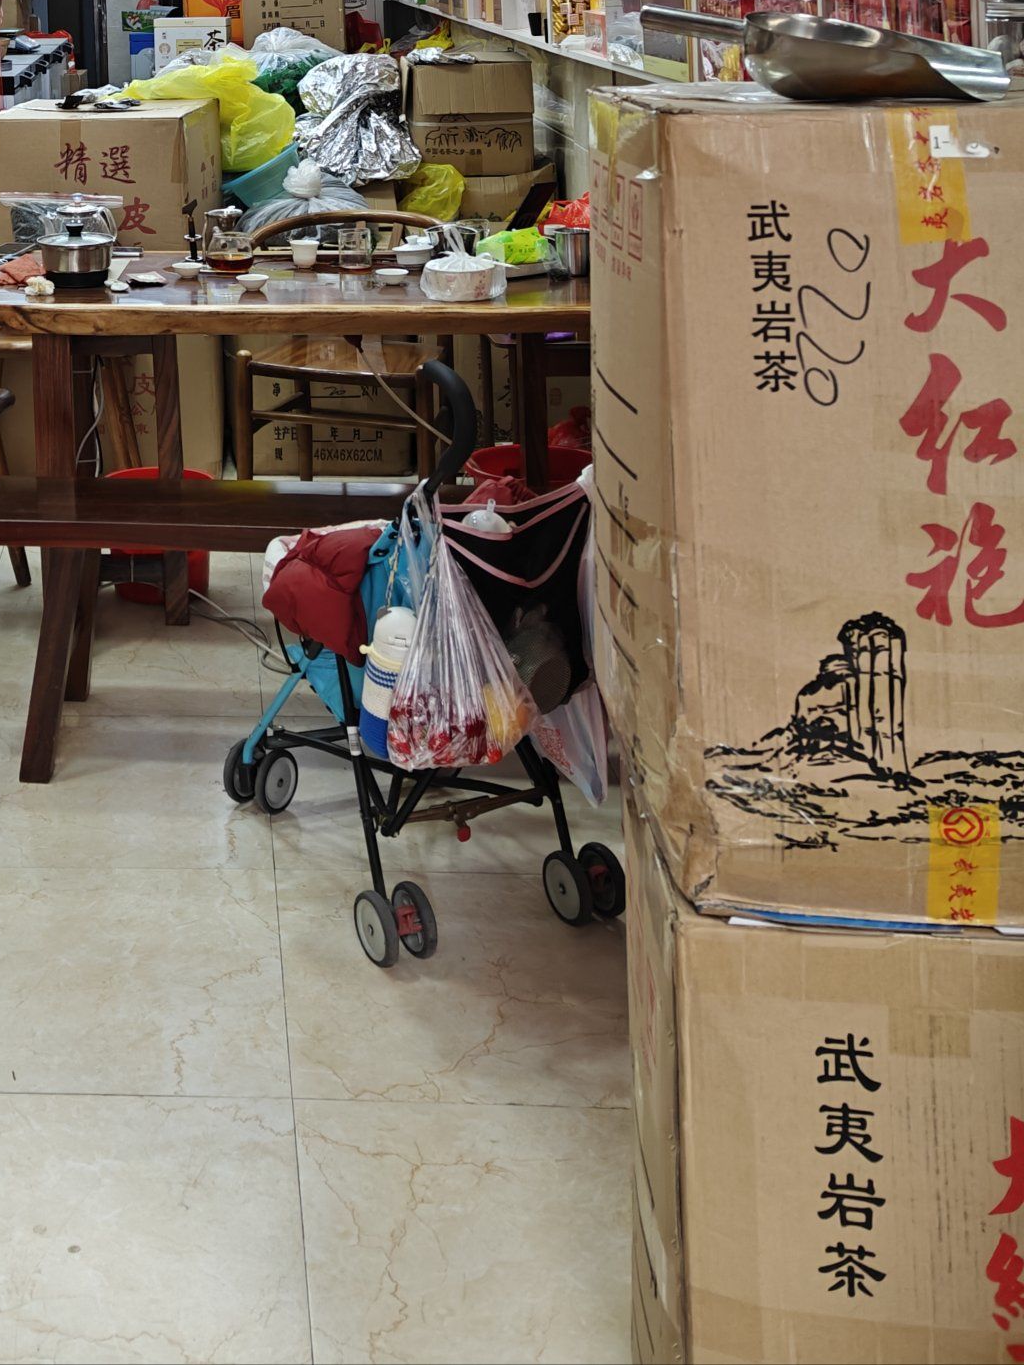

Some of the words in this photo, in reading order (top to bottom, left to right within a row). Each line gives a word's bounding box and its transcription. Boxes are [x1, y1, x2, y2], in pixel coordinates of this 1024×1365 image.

[203, 29, 225, 52] 茶
[54, 141, 136, 185] 精選
[747, 201, 799, 393] 武夷岩茶
[899, 237, 1024, 628] 大红袍
[814, 1033, 887, 1298] 武夷岩茶
